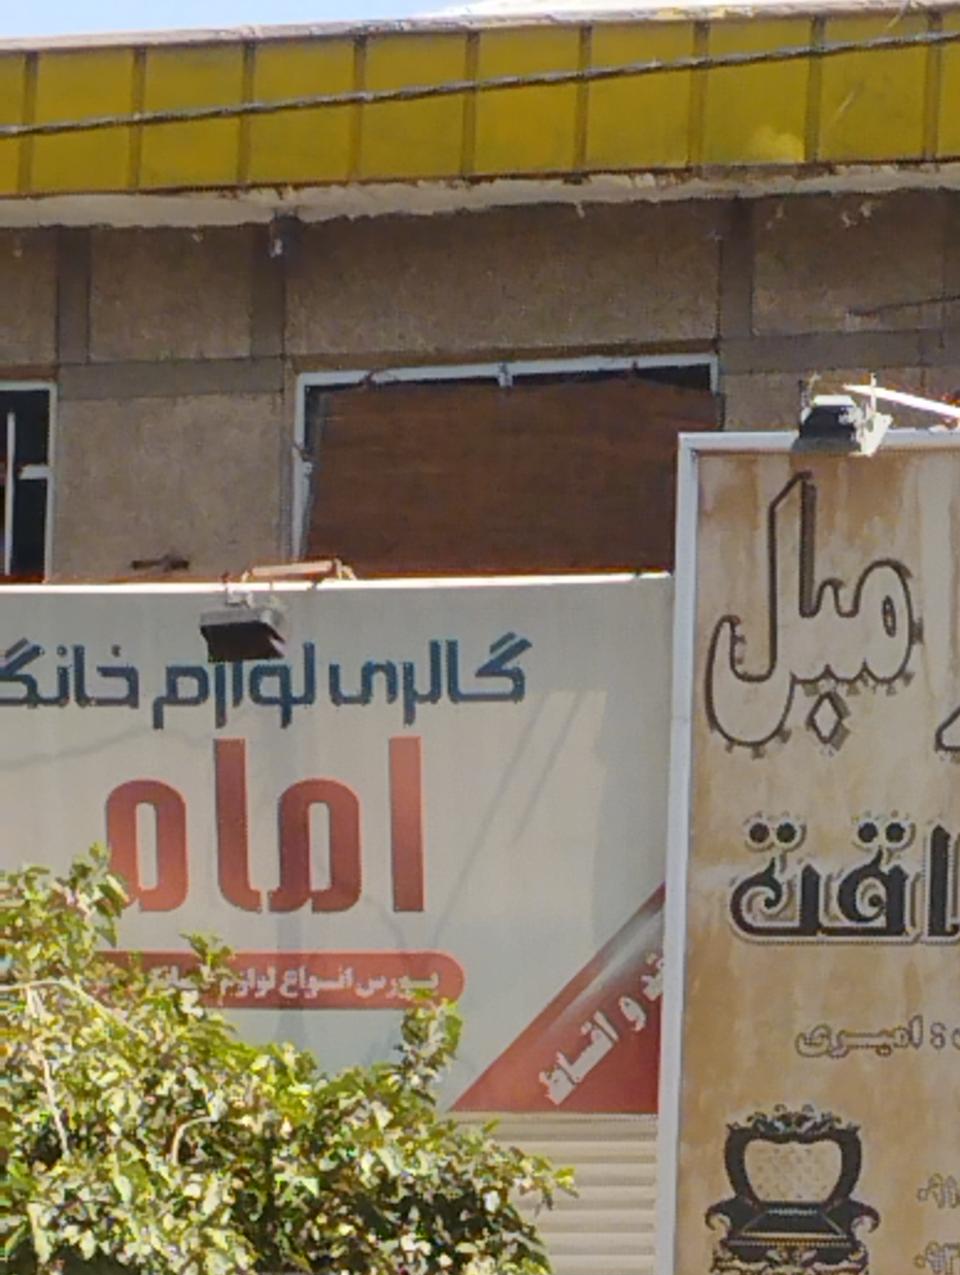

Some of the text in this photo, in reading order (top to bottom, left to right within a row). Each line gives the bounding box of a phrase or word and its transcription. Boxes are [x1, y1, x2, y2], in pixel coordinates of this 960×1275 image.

[0, 638, 140, 709] خانگ
[704, 471, 917, 757] مبل
[104, 735, 425, 914] امام
[795, 1015, 923, 1059] امیری
